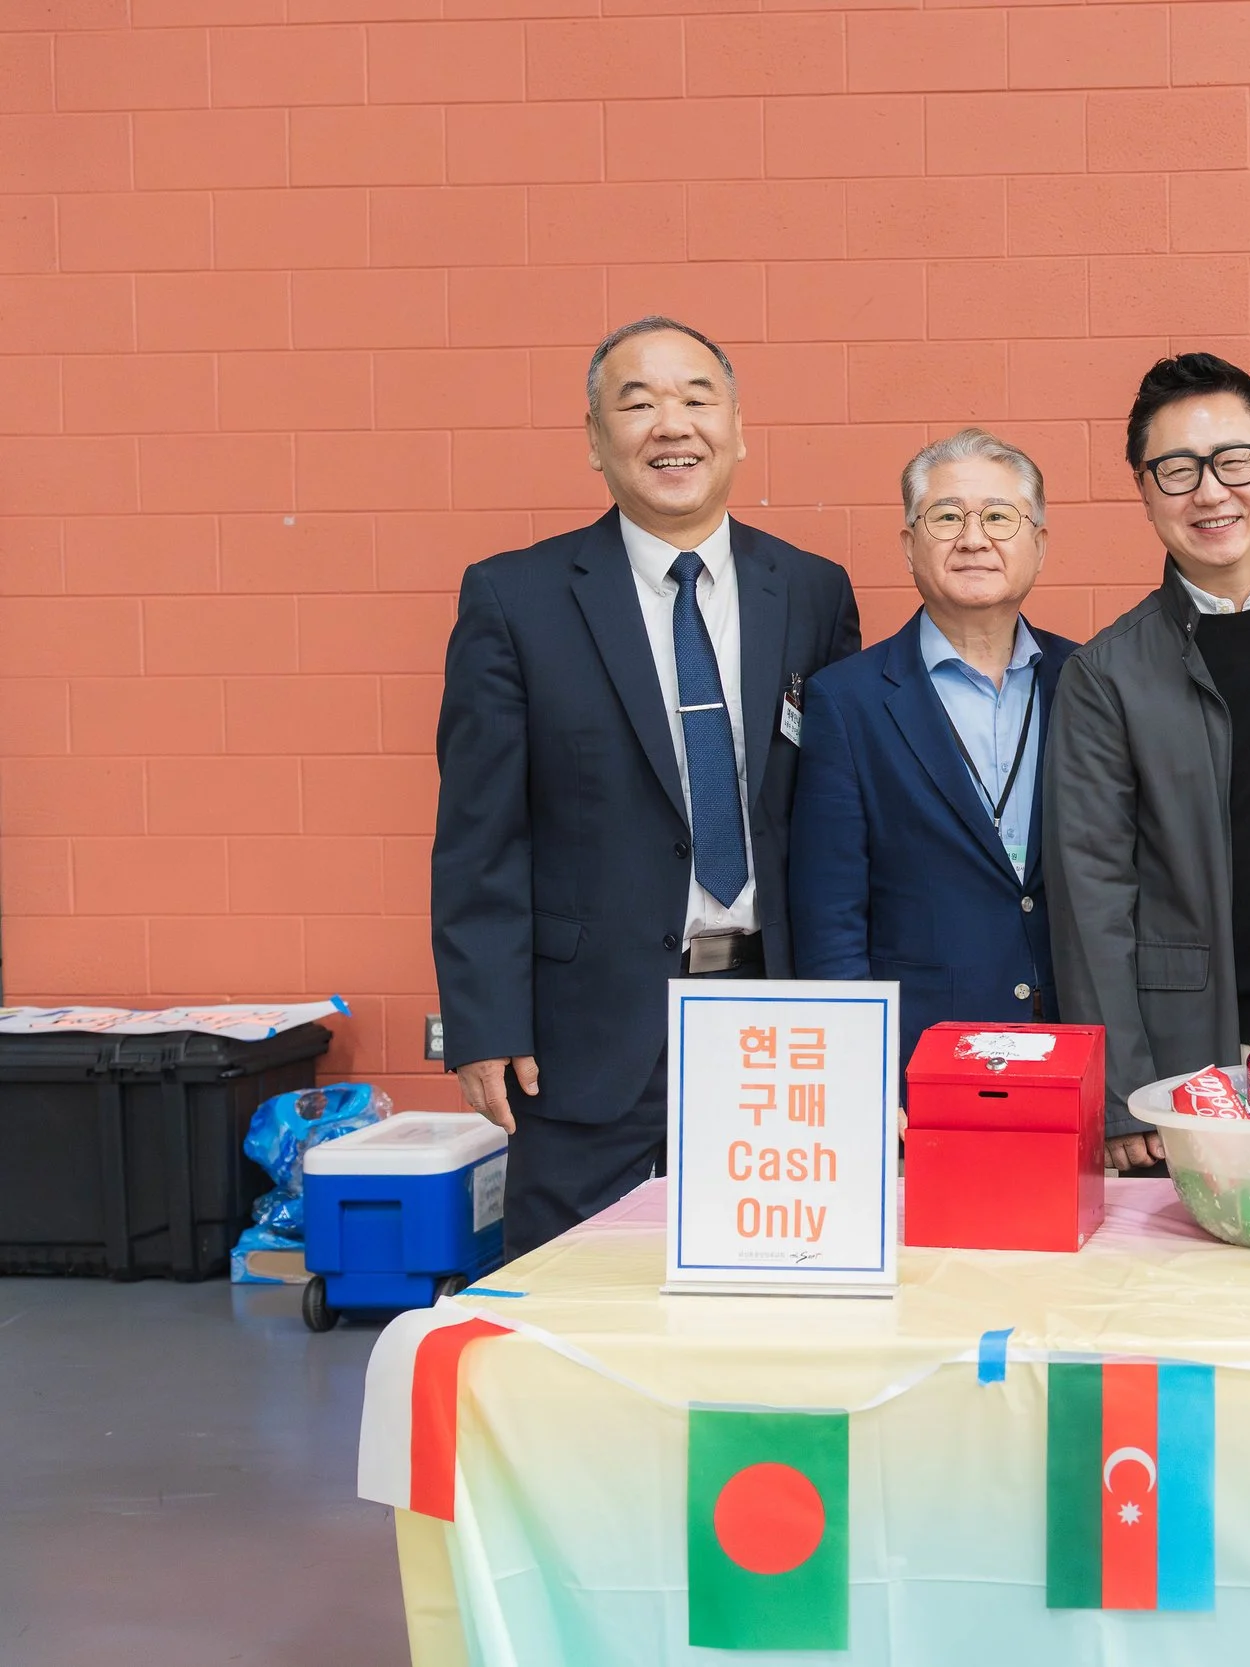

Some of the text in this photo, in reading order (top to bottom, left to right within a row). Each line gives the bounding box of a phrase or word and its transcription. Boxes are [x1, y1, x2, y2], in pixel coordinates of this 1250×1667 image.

[739, 1026, 827, 1070] 현금
[739, 1084, 826, 1127] 구매
[728, 1140, 837, 1182] Cash
[736, 1197, 827, 1242] Only
